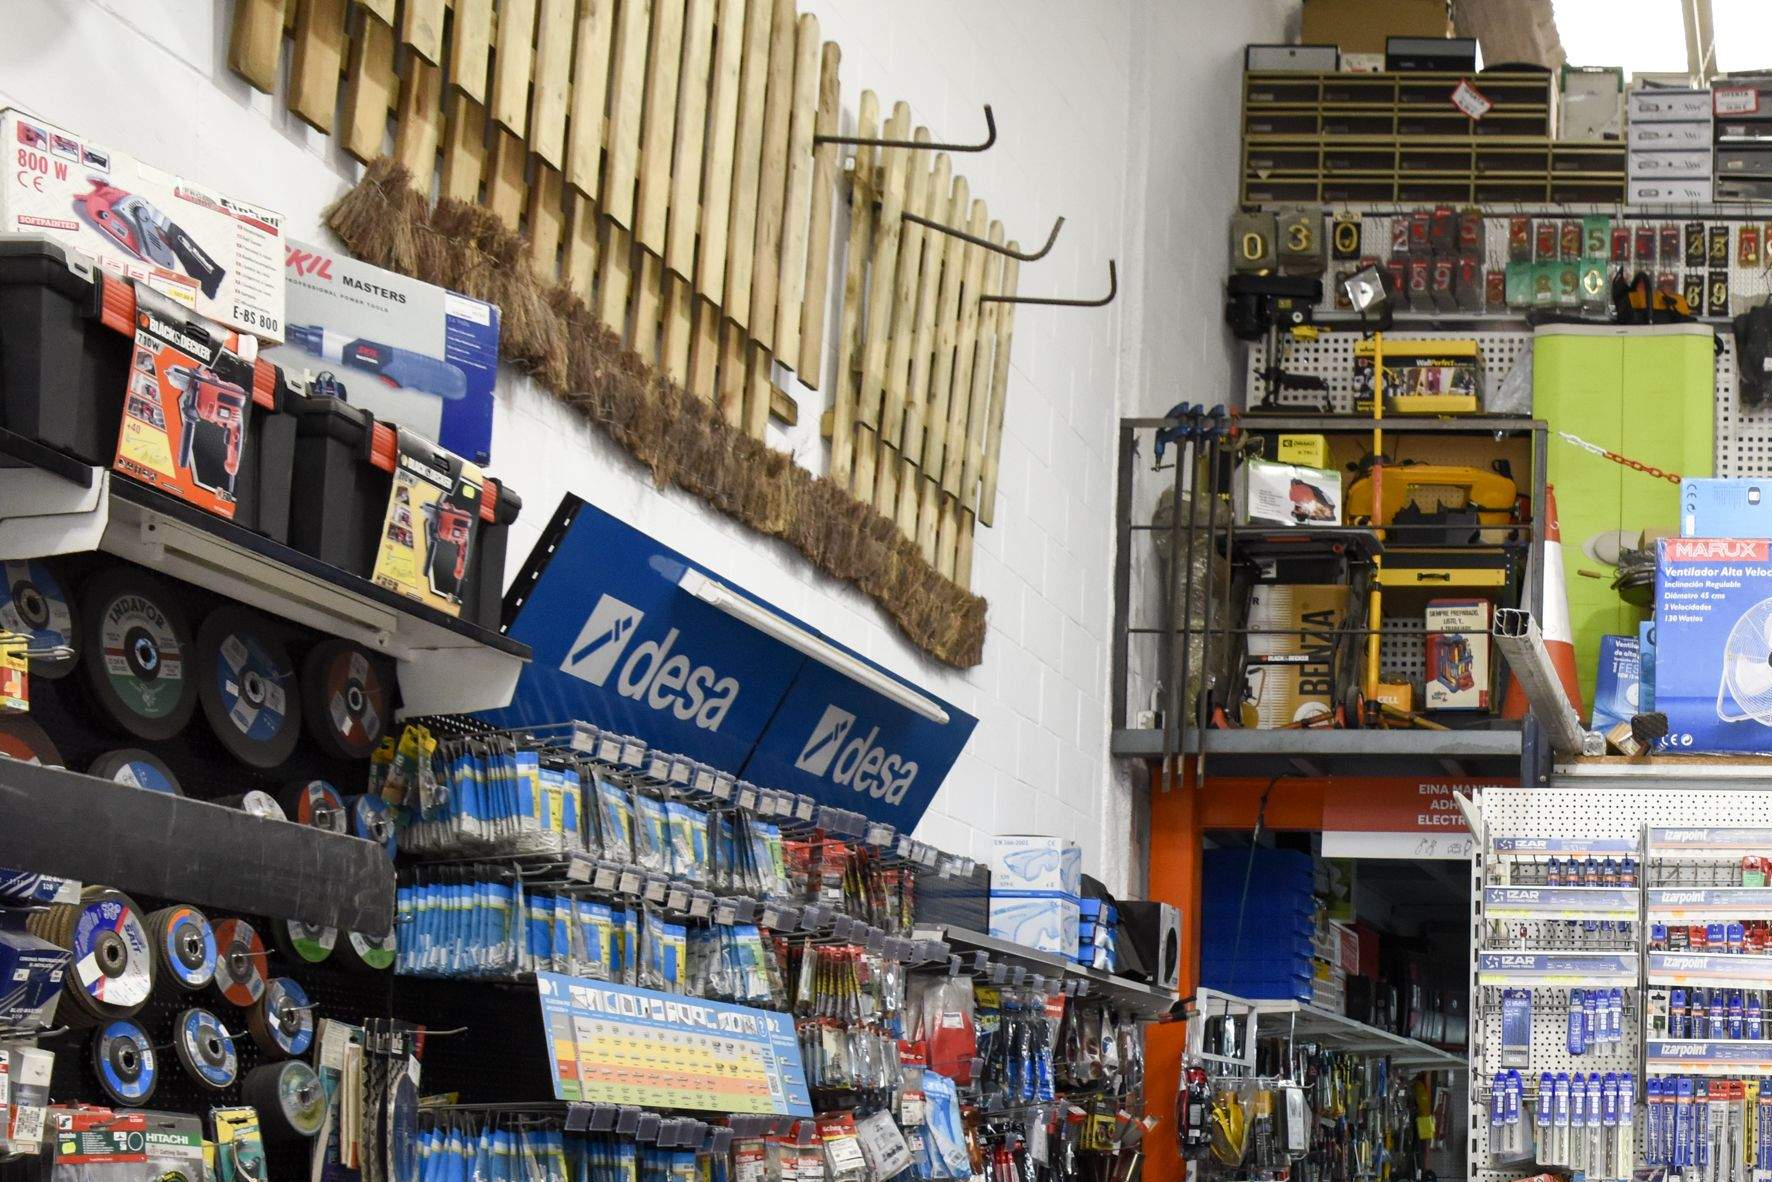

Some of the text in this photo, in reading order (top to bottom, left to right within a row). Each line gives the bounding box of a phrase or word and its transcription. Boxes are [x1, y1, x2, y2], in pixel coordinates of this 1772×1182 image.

[17, 148, 69, 183] 800 W
[285, 245, 408, 305] KIL MASTERS
[233, 305, 279, 333] E-BS 800
[1674, 541, 1758, 559] MARUX
[1664, 566, 1720, 578] Ventilador
[1720, 567, 1744, 578] Alta
[1664, 579, 1742, 590] Inclinación Regulable
[1664, 591, 1700, 600] Diámetro
[109, 595, 166, 630] INDAVOR
[1670, 603, 1712, 612] Velocidades
[616, 627, 741, 733] desa
[833, 726, 920, 806] desa
[1418, 784, 1449, 795] EINA
[1418, 814, 1467, 826] ELECTR
[1515, 839, 1547, 849] IZAR
[1506, 889, 1541, 899] IZAR
[1501, 955, 1536, 965] IZAR
[146, 1132, 189, 1145] HITACHI
